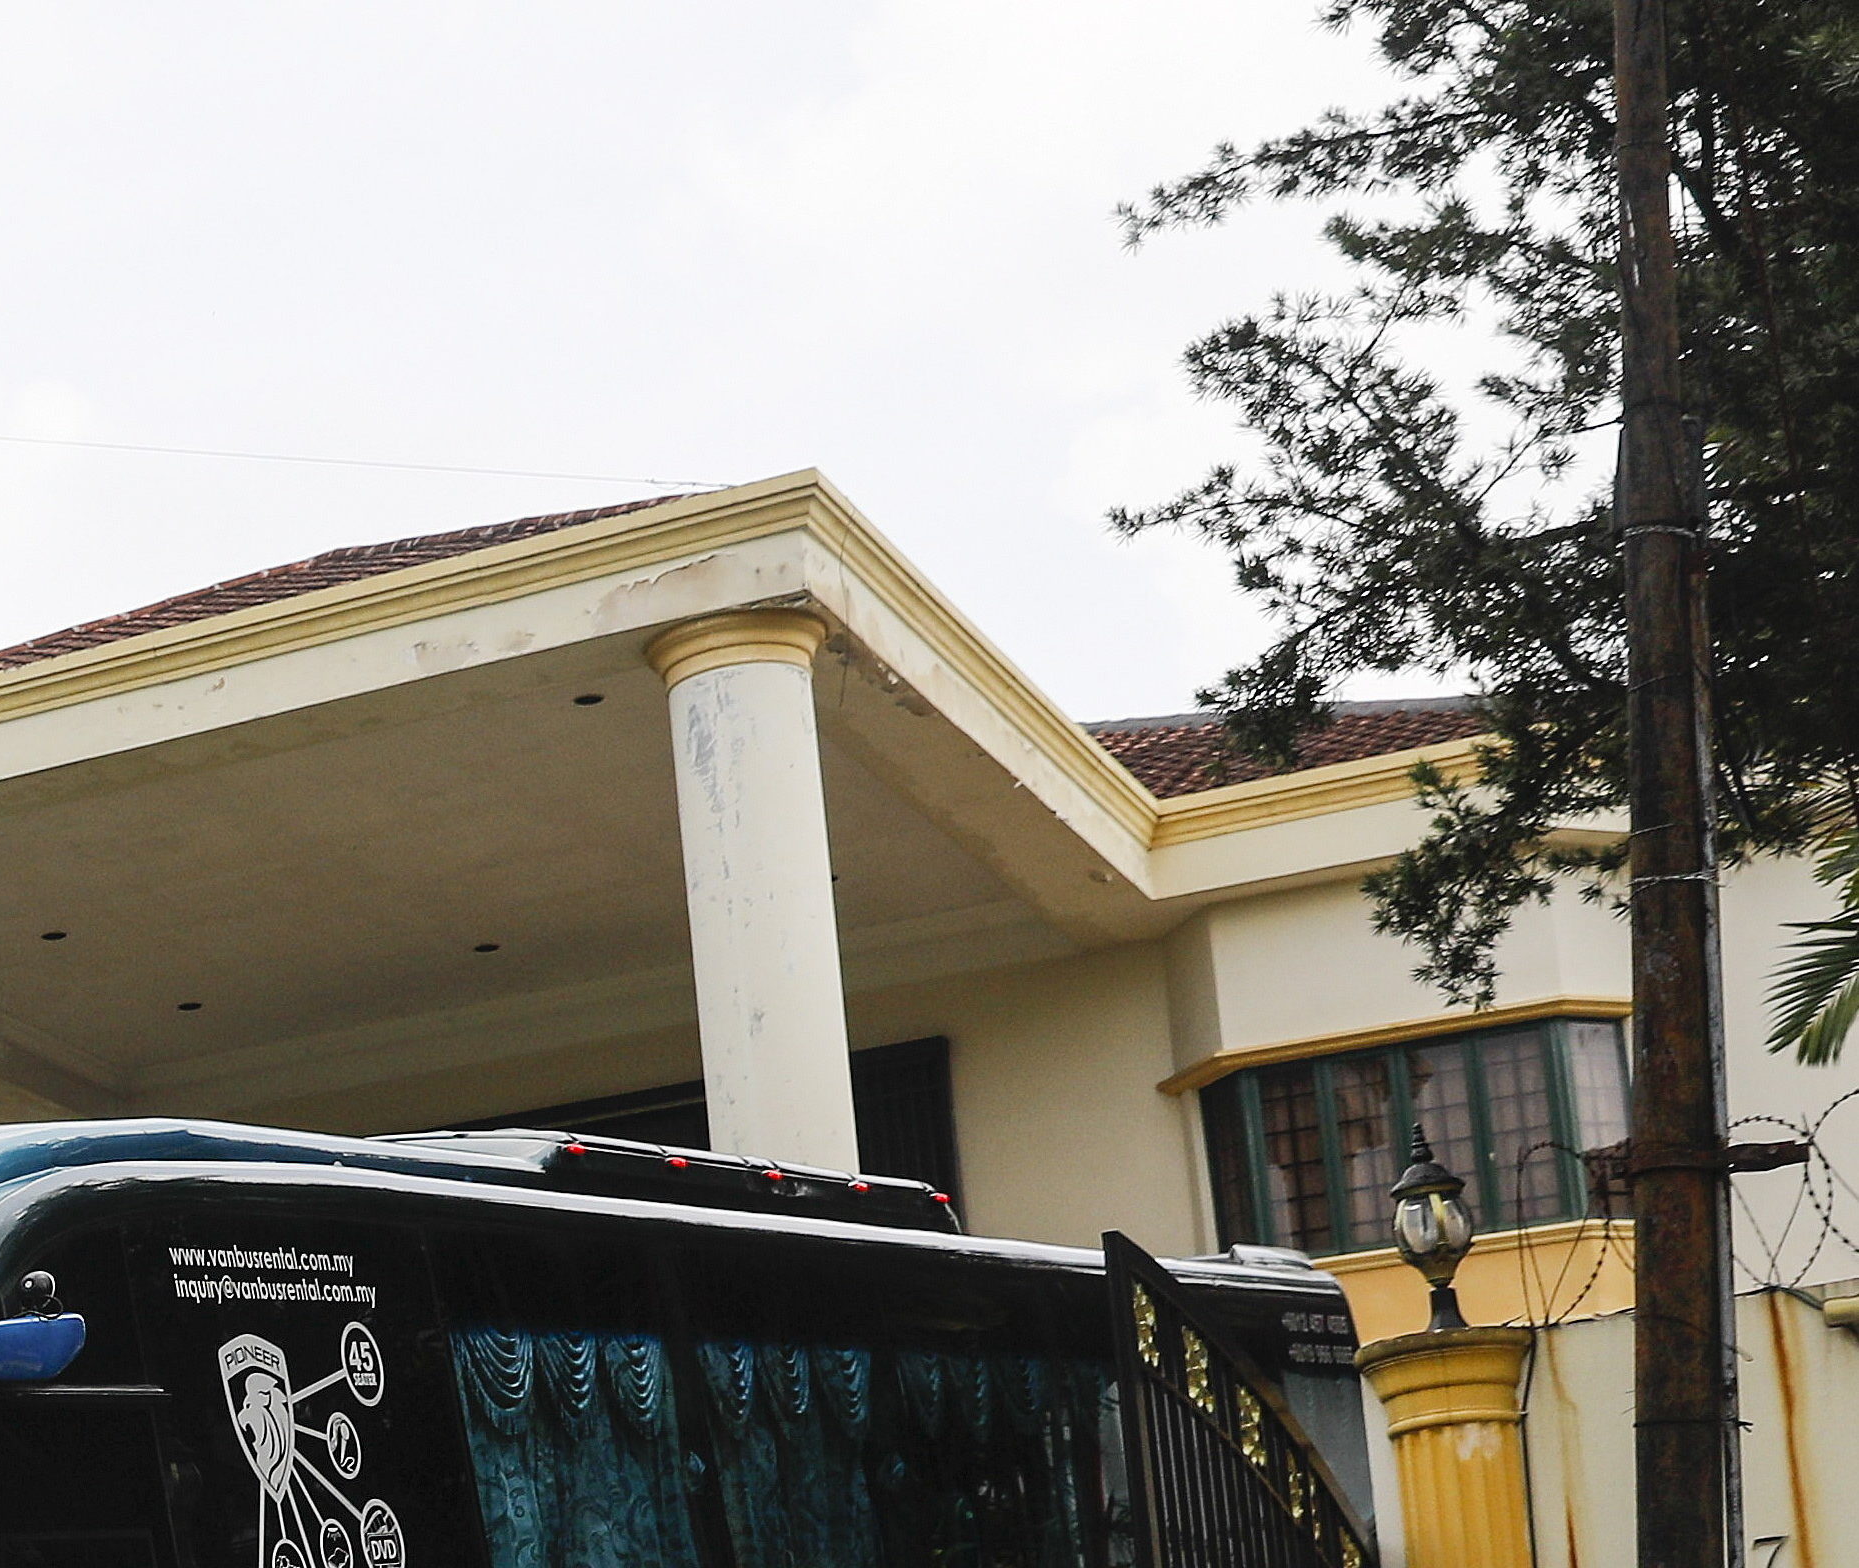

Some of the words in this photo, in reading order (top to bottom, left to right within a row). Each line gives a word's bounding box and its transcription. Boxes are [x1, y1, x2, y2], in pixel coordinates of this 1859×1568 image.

[168, 1244, 354, 1278] www.vanbusrental.com.my
[173, 1273, 376, 1309] inquiry@vanbusrental.com.my
[224, 1345, 280, 1372] PIONEER
[348, 1340, 375, 1372] 45
[370, 1539, 397, 1560] DVD
